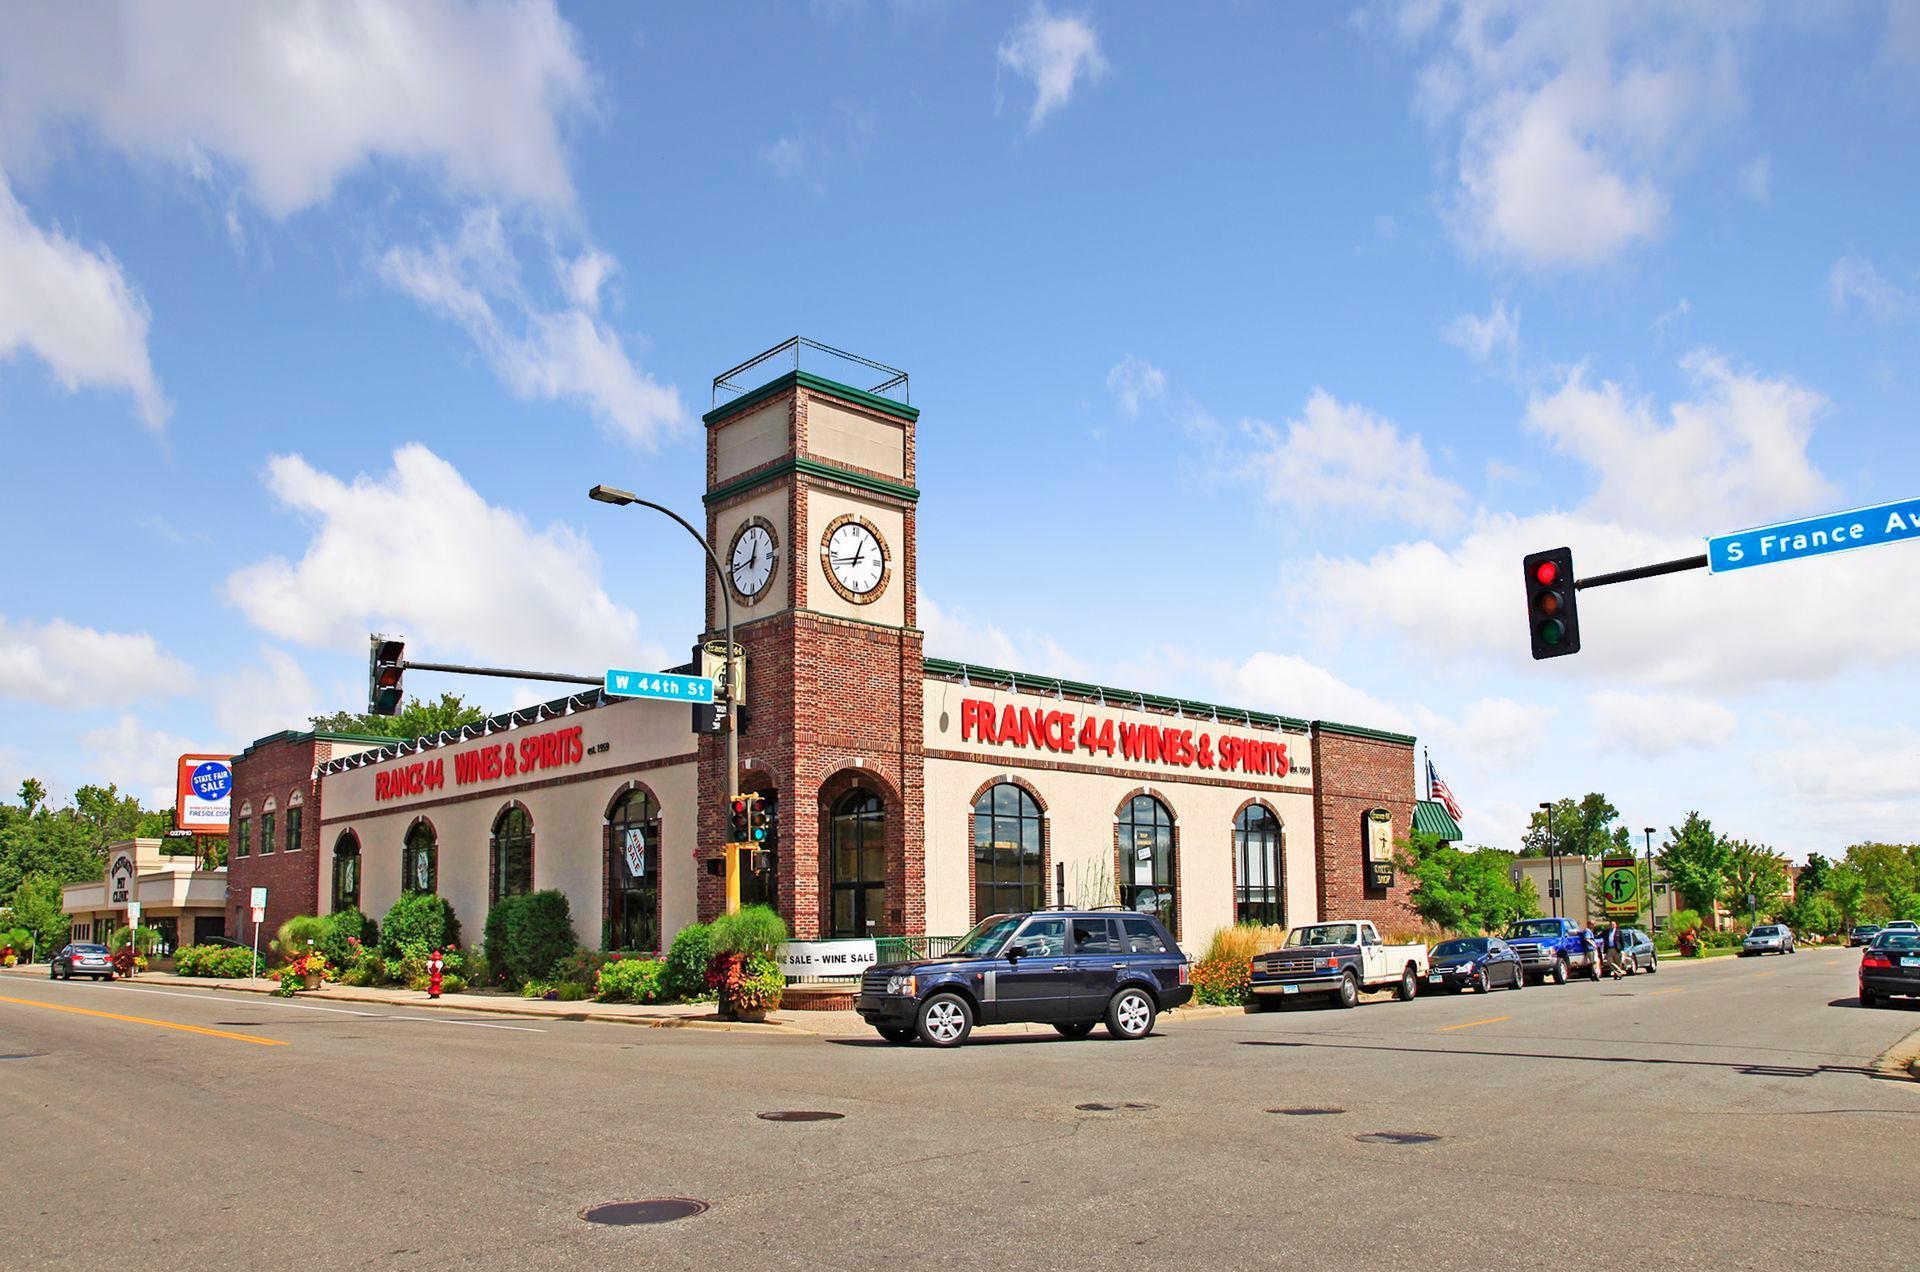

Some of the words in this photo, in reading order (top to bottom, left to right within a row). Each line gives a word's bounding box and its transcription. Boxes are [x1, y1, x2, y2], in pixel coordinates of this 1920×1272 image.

[1727, 542, 1744, 561] S
[1760, 523, 1865, 556] France
[615, 675, 629, 689] W
[638, 678, 679, 694] 44th
[687, 682, 704, 697] St
[961, 699, 1076, 752] FRANCE
[1079, 717, 1116, 755] 44
[1118, 722, 1196, 767] WINES
[1197, 733, 1215, 769] &
[1217, 735, 1290, 777] SPIRITS
[193, 773, 212, 784] STATE
[213, 770, 229, 781] FAIR
[375, 762, 424, 801] FRANCE
[424, 758, 444, 790] 44
[454, 744, 502, 785] WINES
[504, 743, 517, 777] &
[519, 725, 584, 773] SPIRITS
[201, 780, 226, 793] SALE
[627, 844, 641, 873] SALE
[633, 831, 644, 860] WINE
[789, 955, 812, 965] SALE
[822, 954, 847, 964] WINE
[850, 953, 875, 963] SALE
